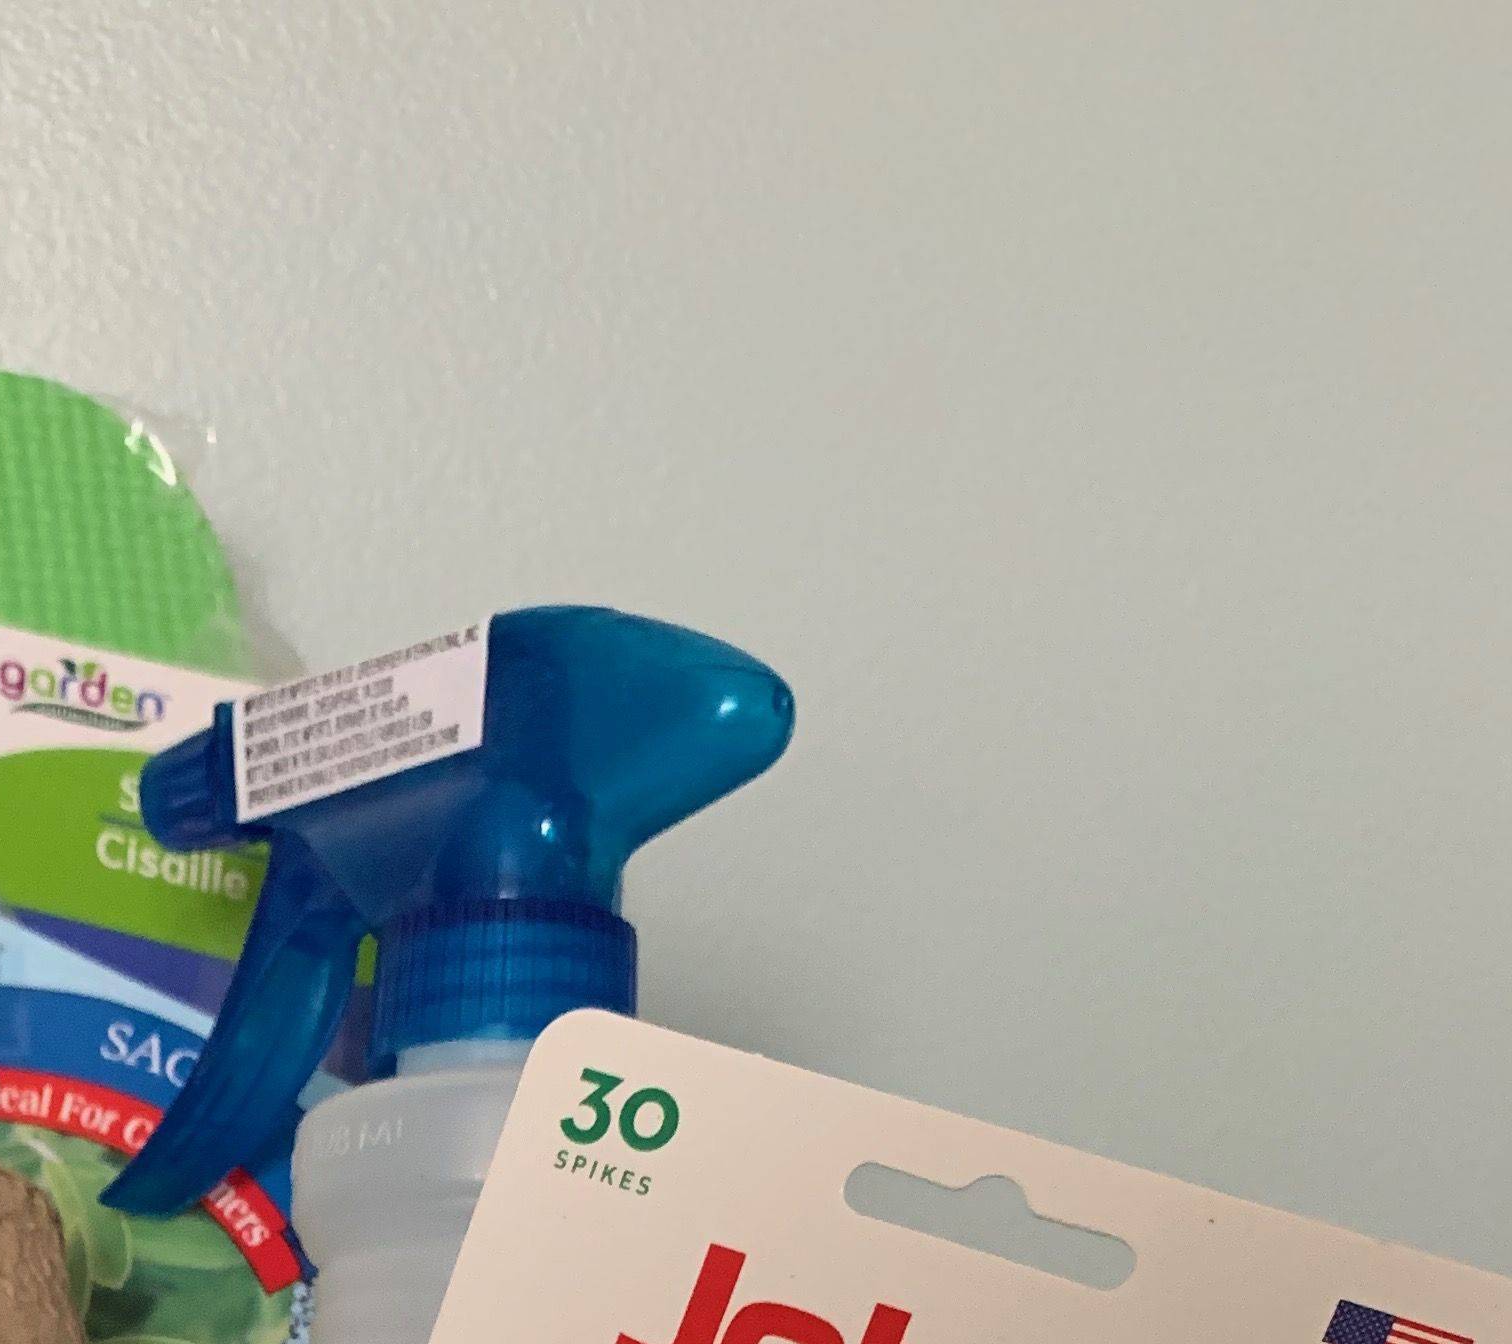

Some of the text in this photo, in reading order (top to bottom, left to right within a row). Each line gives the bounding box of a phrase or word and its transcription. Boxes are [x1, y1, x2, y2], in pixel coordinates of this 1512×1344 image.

[57, 1090, 122, 1137] For
[559, 1067, 680, 1152] 30
[553, 1148, 653, 1196] SPIKES
